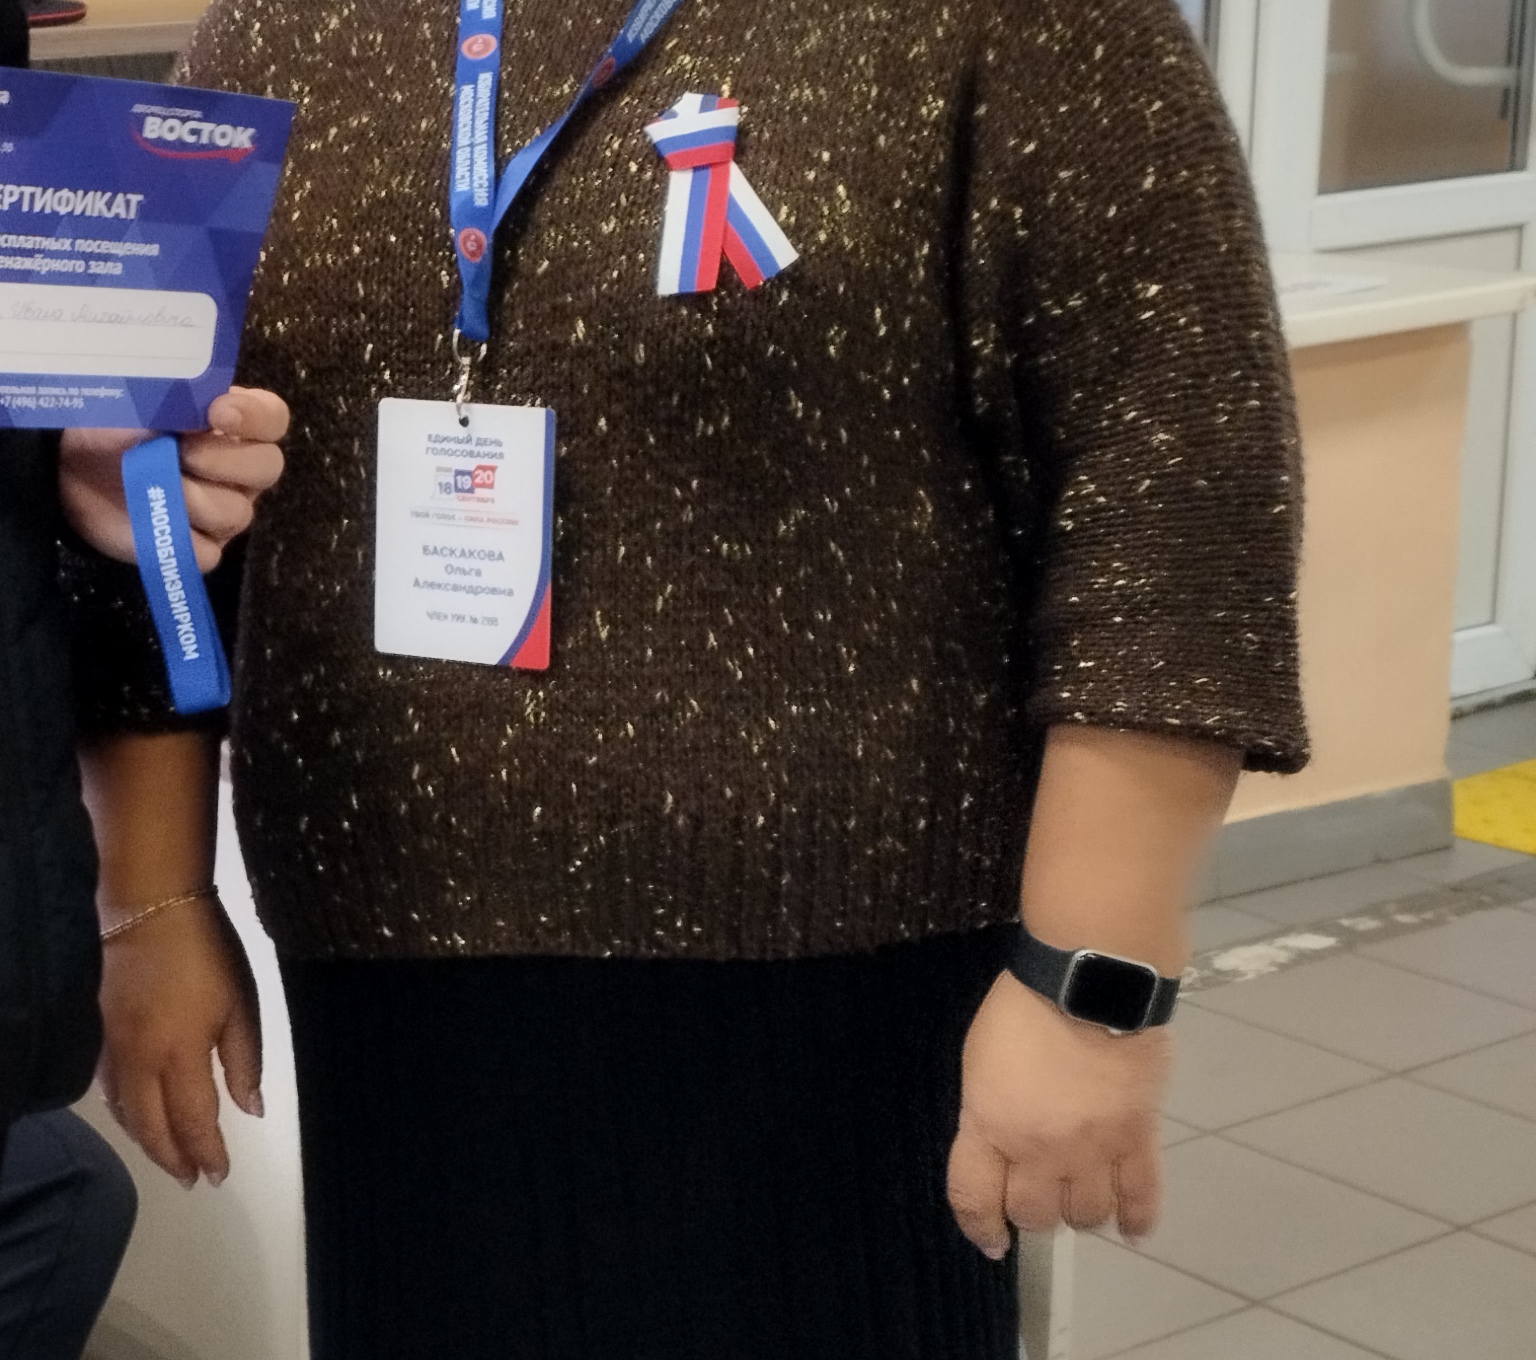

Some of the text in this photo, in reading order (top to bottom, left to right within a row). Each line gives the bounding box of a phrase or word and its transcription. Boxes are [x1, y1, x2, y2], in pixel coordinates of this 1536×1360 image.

[142, 116, 256, 148] ВОСТОК
[74, 238, 160, 257] посещения
[87, 259, 123, 275] зала
[427, 433, 503, 448] ЕДИНЫЙ ДЕНЬ
[425, 446, 505, 460] ГОЛОСОВАНИЯ
[438, 469, 494, 495] 18 19 20
[422, 544, 505, 562] БАСКАКОВА
[146, 485, 200, 662] #МОСОБЛИЗБИРКОМ
[444, 563, 482, 577] Ольга
[412, 577, 514, 597] Александровна
